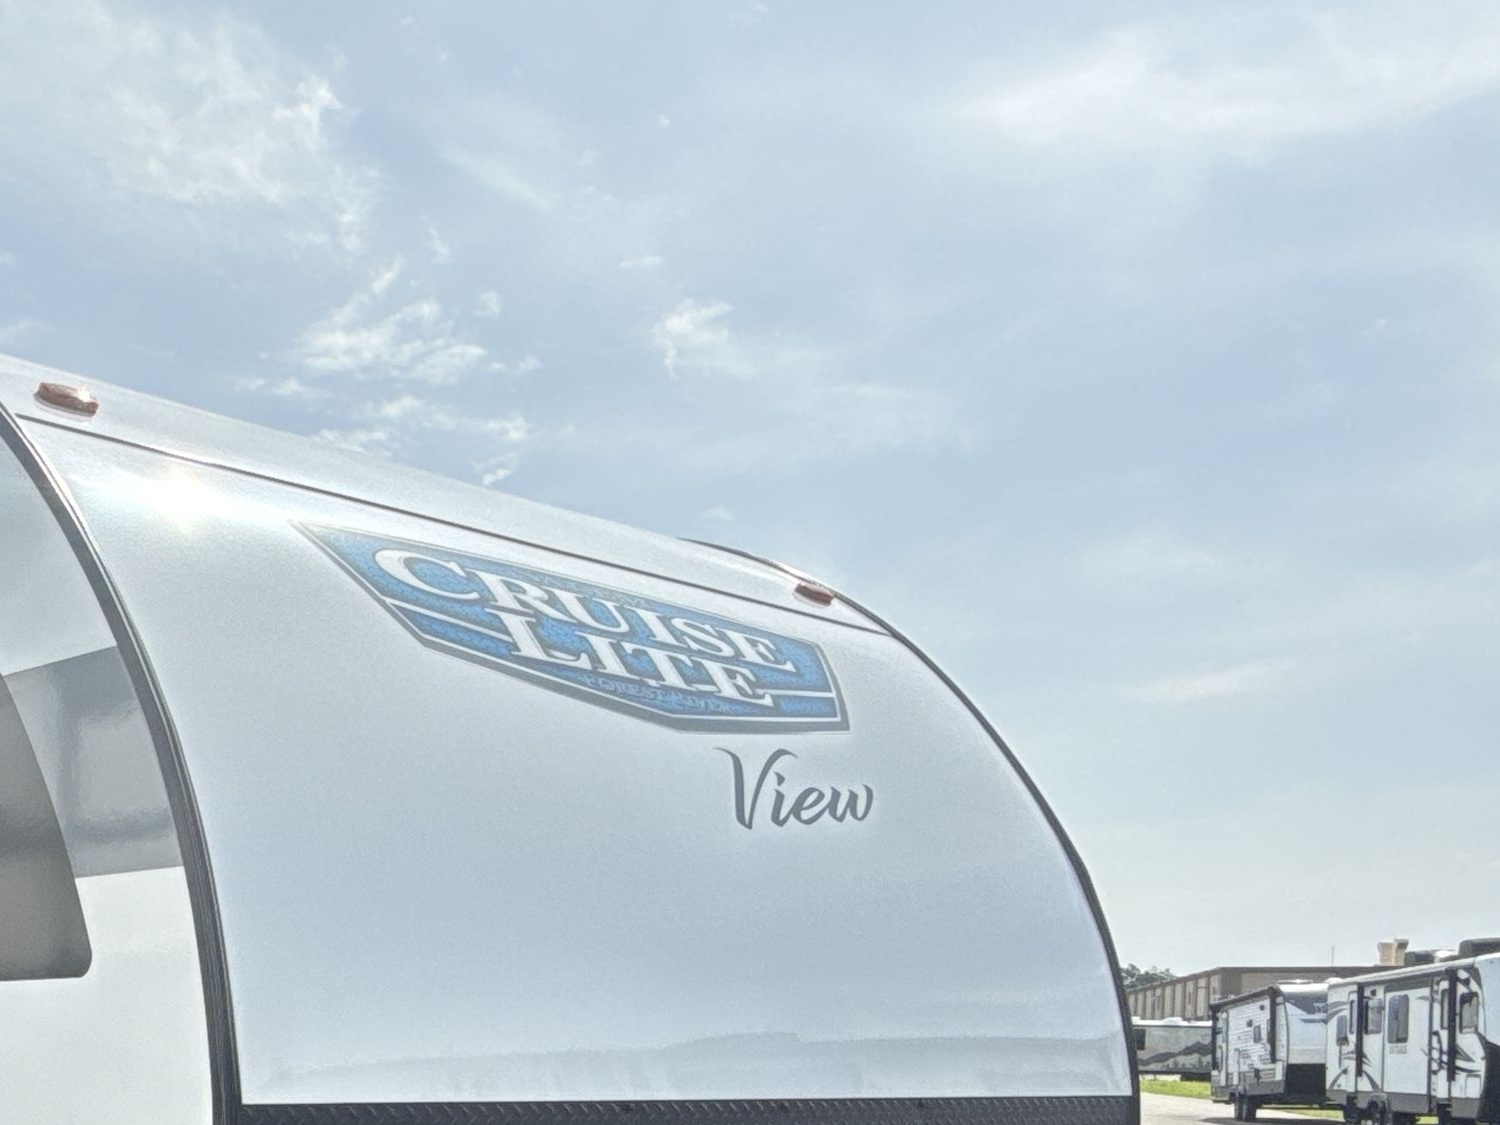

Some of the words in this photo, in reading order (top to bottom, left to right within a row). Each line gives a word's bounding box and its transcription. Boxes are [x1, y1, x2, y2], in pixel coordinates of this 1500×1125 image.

[374, 549, 795, 671] CRUISE
[484, 607, 773, 707] LITE
[712, 746, 874, 830] View
